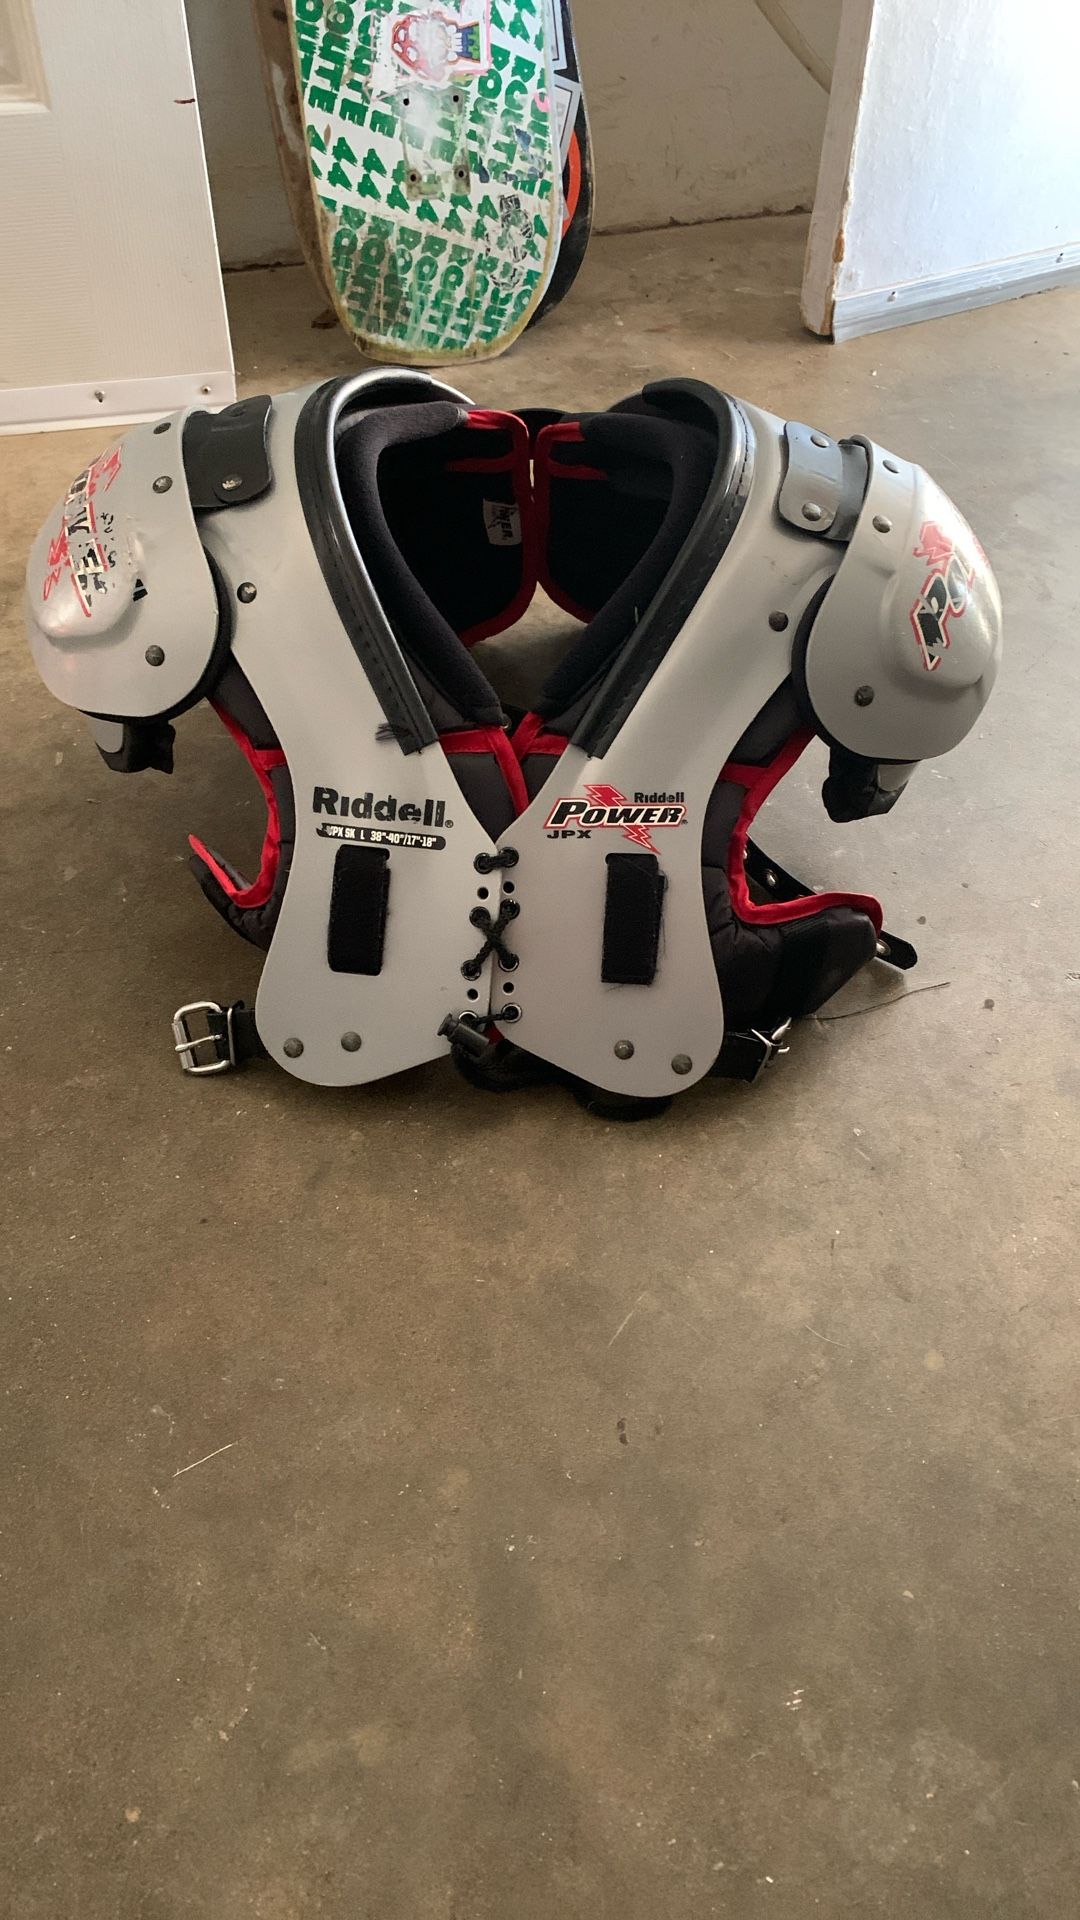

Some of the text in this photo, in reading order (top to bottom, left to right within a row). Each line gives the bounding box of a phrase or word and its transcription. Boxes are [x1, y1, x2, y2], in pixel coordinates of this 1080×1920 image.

[327, 136, 358, 192] 44
[357, 148, 388, 203] 44
[313, 786, 446, 828] Riddell
[634, 792, 685, 803] Riddell
[546, 799, 685, 826] POWER
[360, 830, 366, 840] L
[547, 830, 592, 839] JPX
